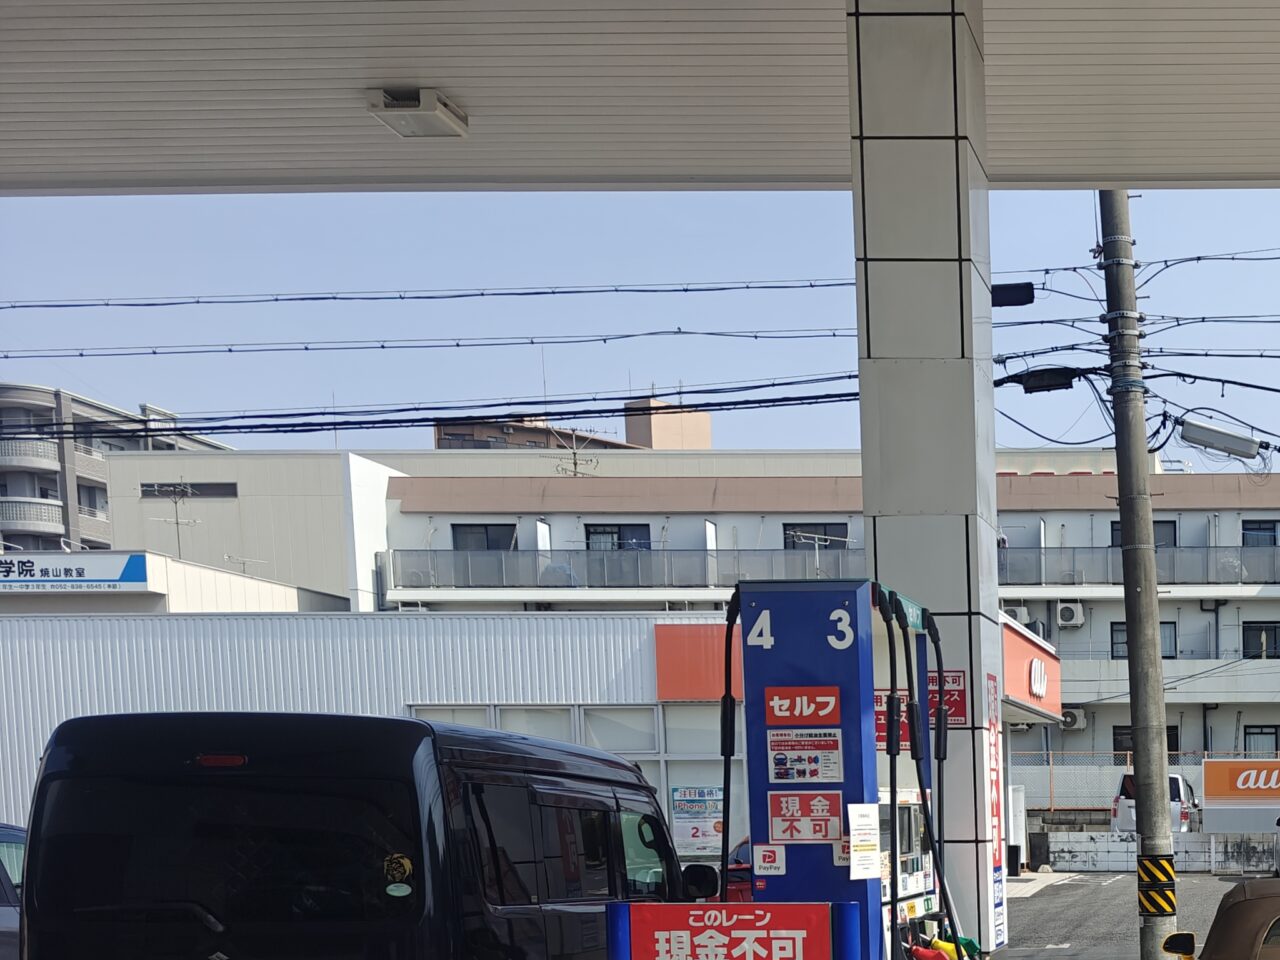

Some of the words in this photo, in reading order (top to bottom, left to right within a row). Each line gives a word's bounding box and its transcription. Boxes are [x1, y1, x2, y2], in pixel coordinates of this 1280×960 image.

[40, 567, 86, 578] 焼山教室
[747, 609, 775, 650] 4
[827, 608, 855, 650] 3
[769, 695, 836, 717] セルフ
[675, 801, 705, 811] iPhone
[780, 795, 831, 817] 現金
[781, 818, 831, 838] 不可
[688, 909, 772, 927] このレーン
